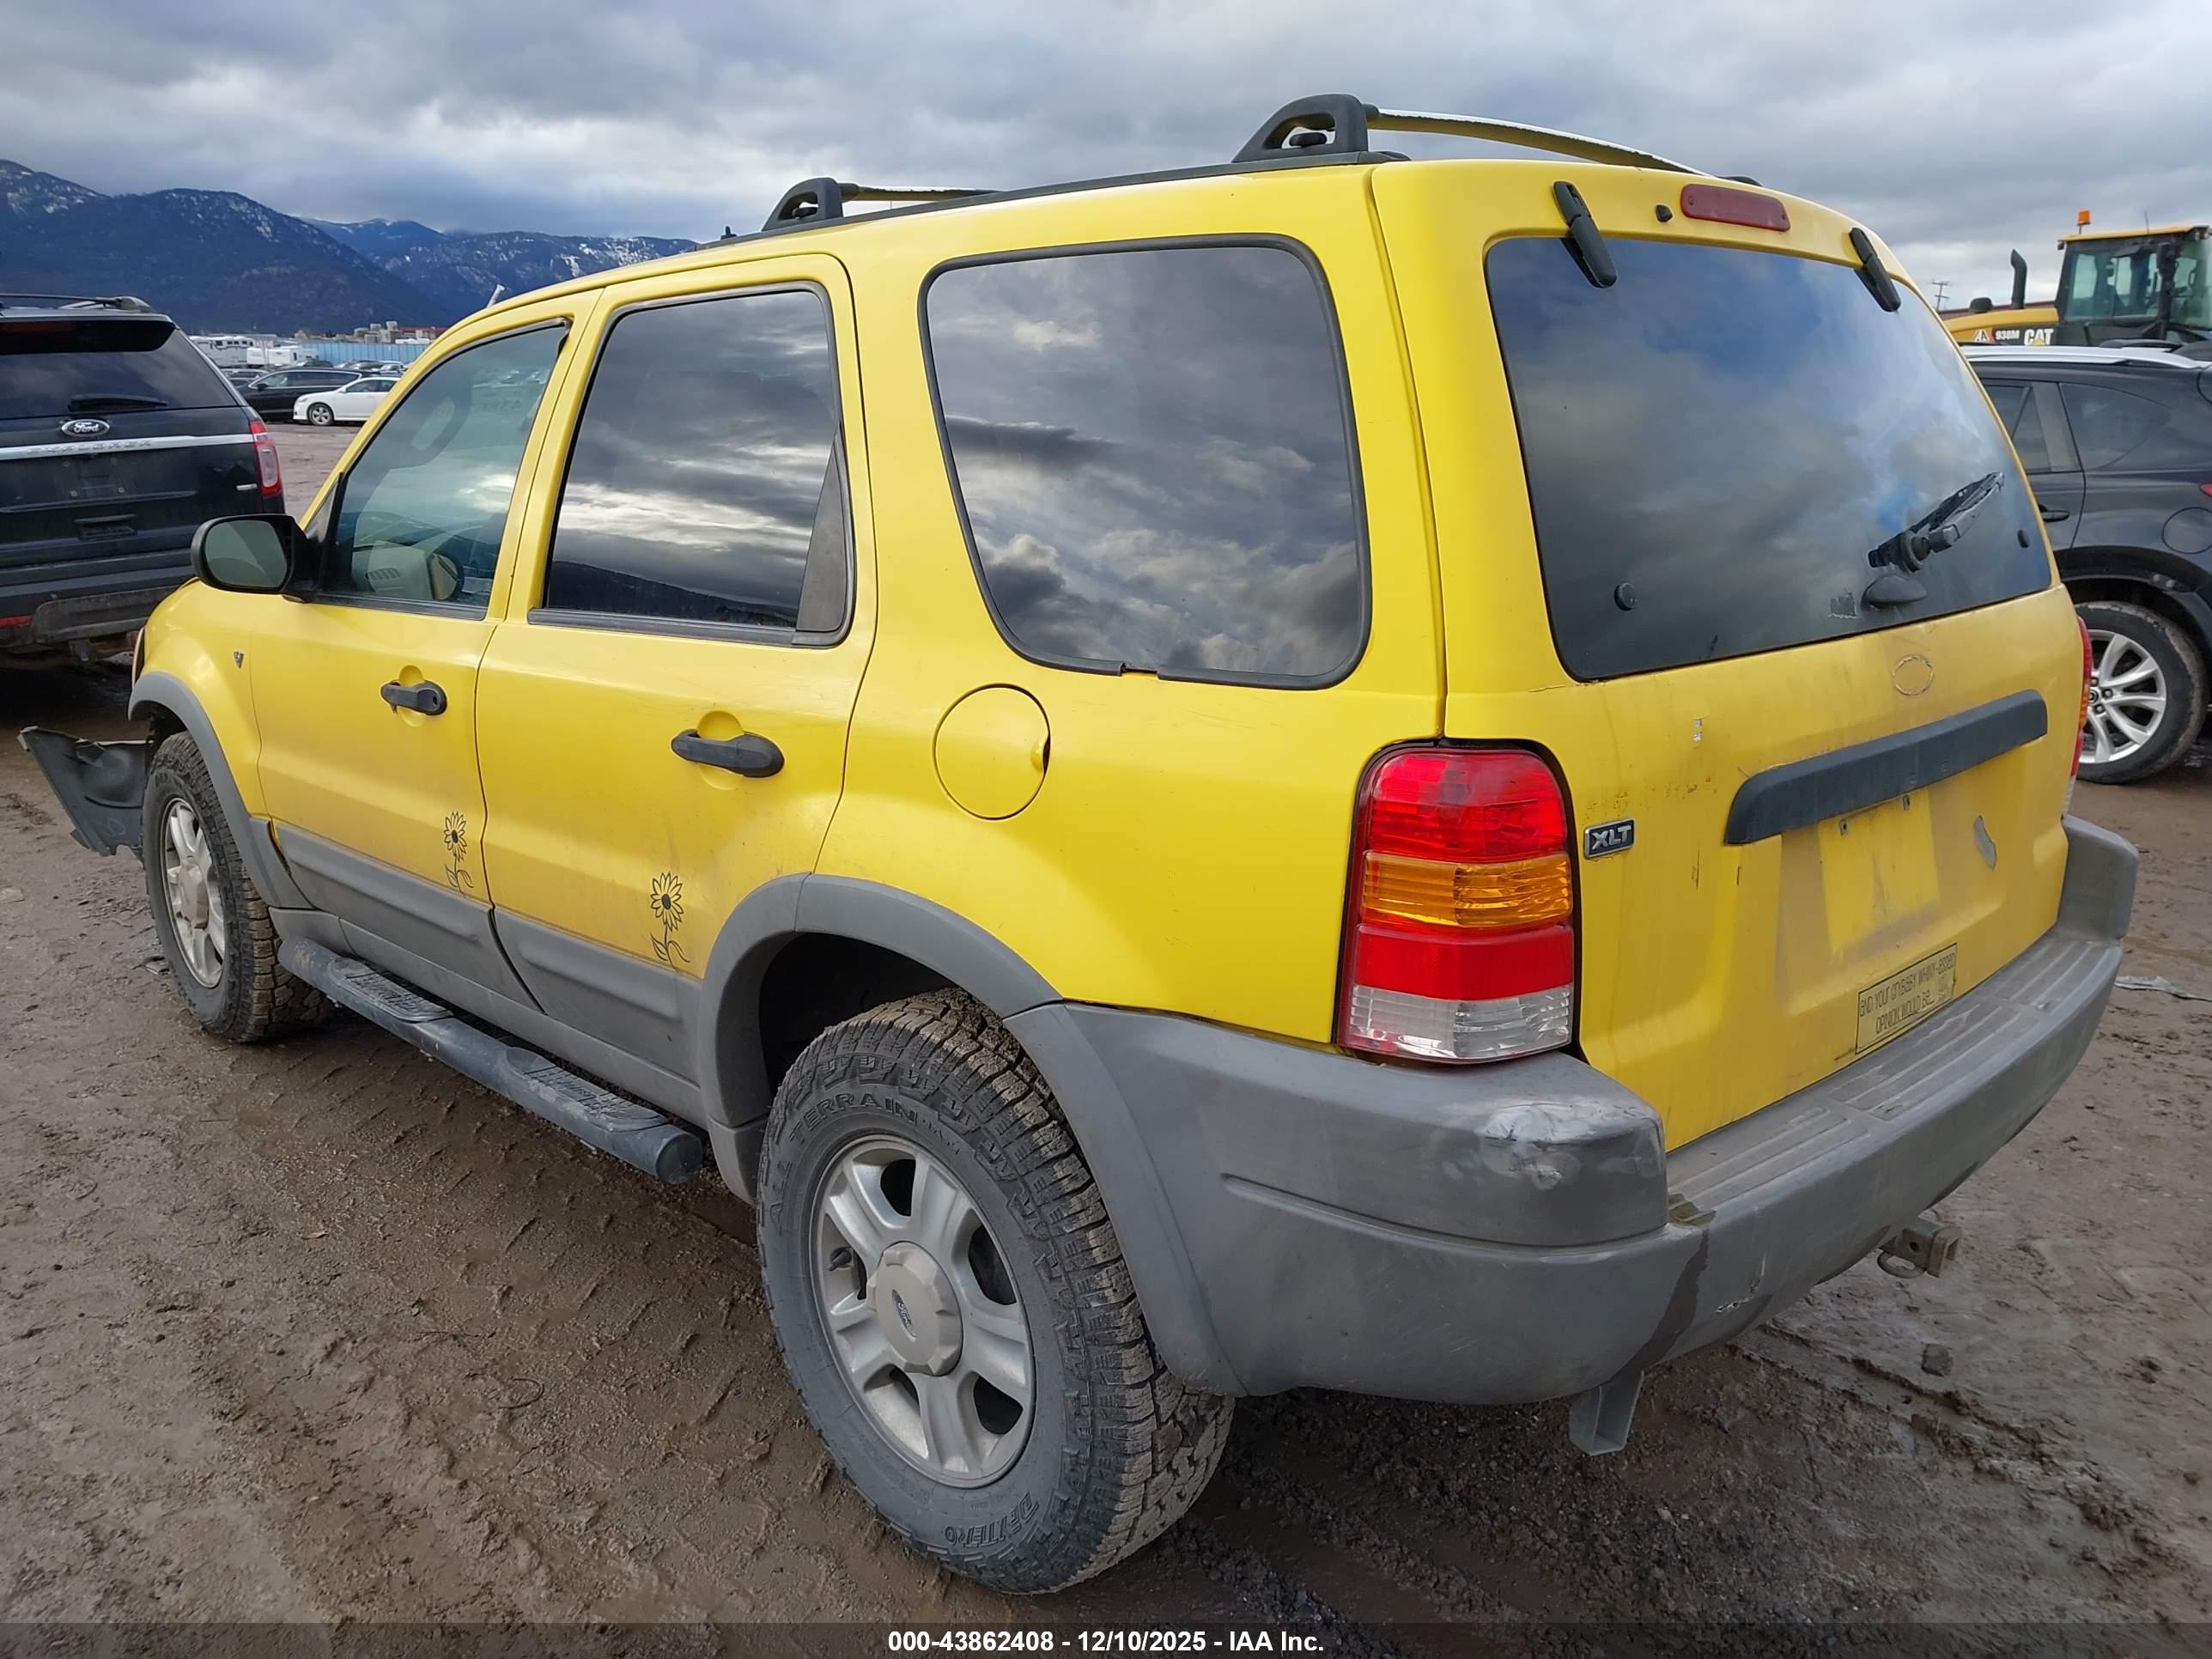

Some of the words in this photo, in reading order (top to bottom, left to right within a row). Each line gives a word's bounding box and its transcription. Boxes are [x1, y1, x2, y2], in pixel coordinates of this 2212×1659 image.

[1995, 329, 2021, 341] 938M
[2023, 328, 2054, 345] CAT
[73, 421, 100, 434] Ford
[1590, 824, 1632, 850] XLT
[789, 1092, 918, 1146] TERRAIN
